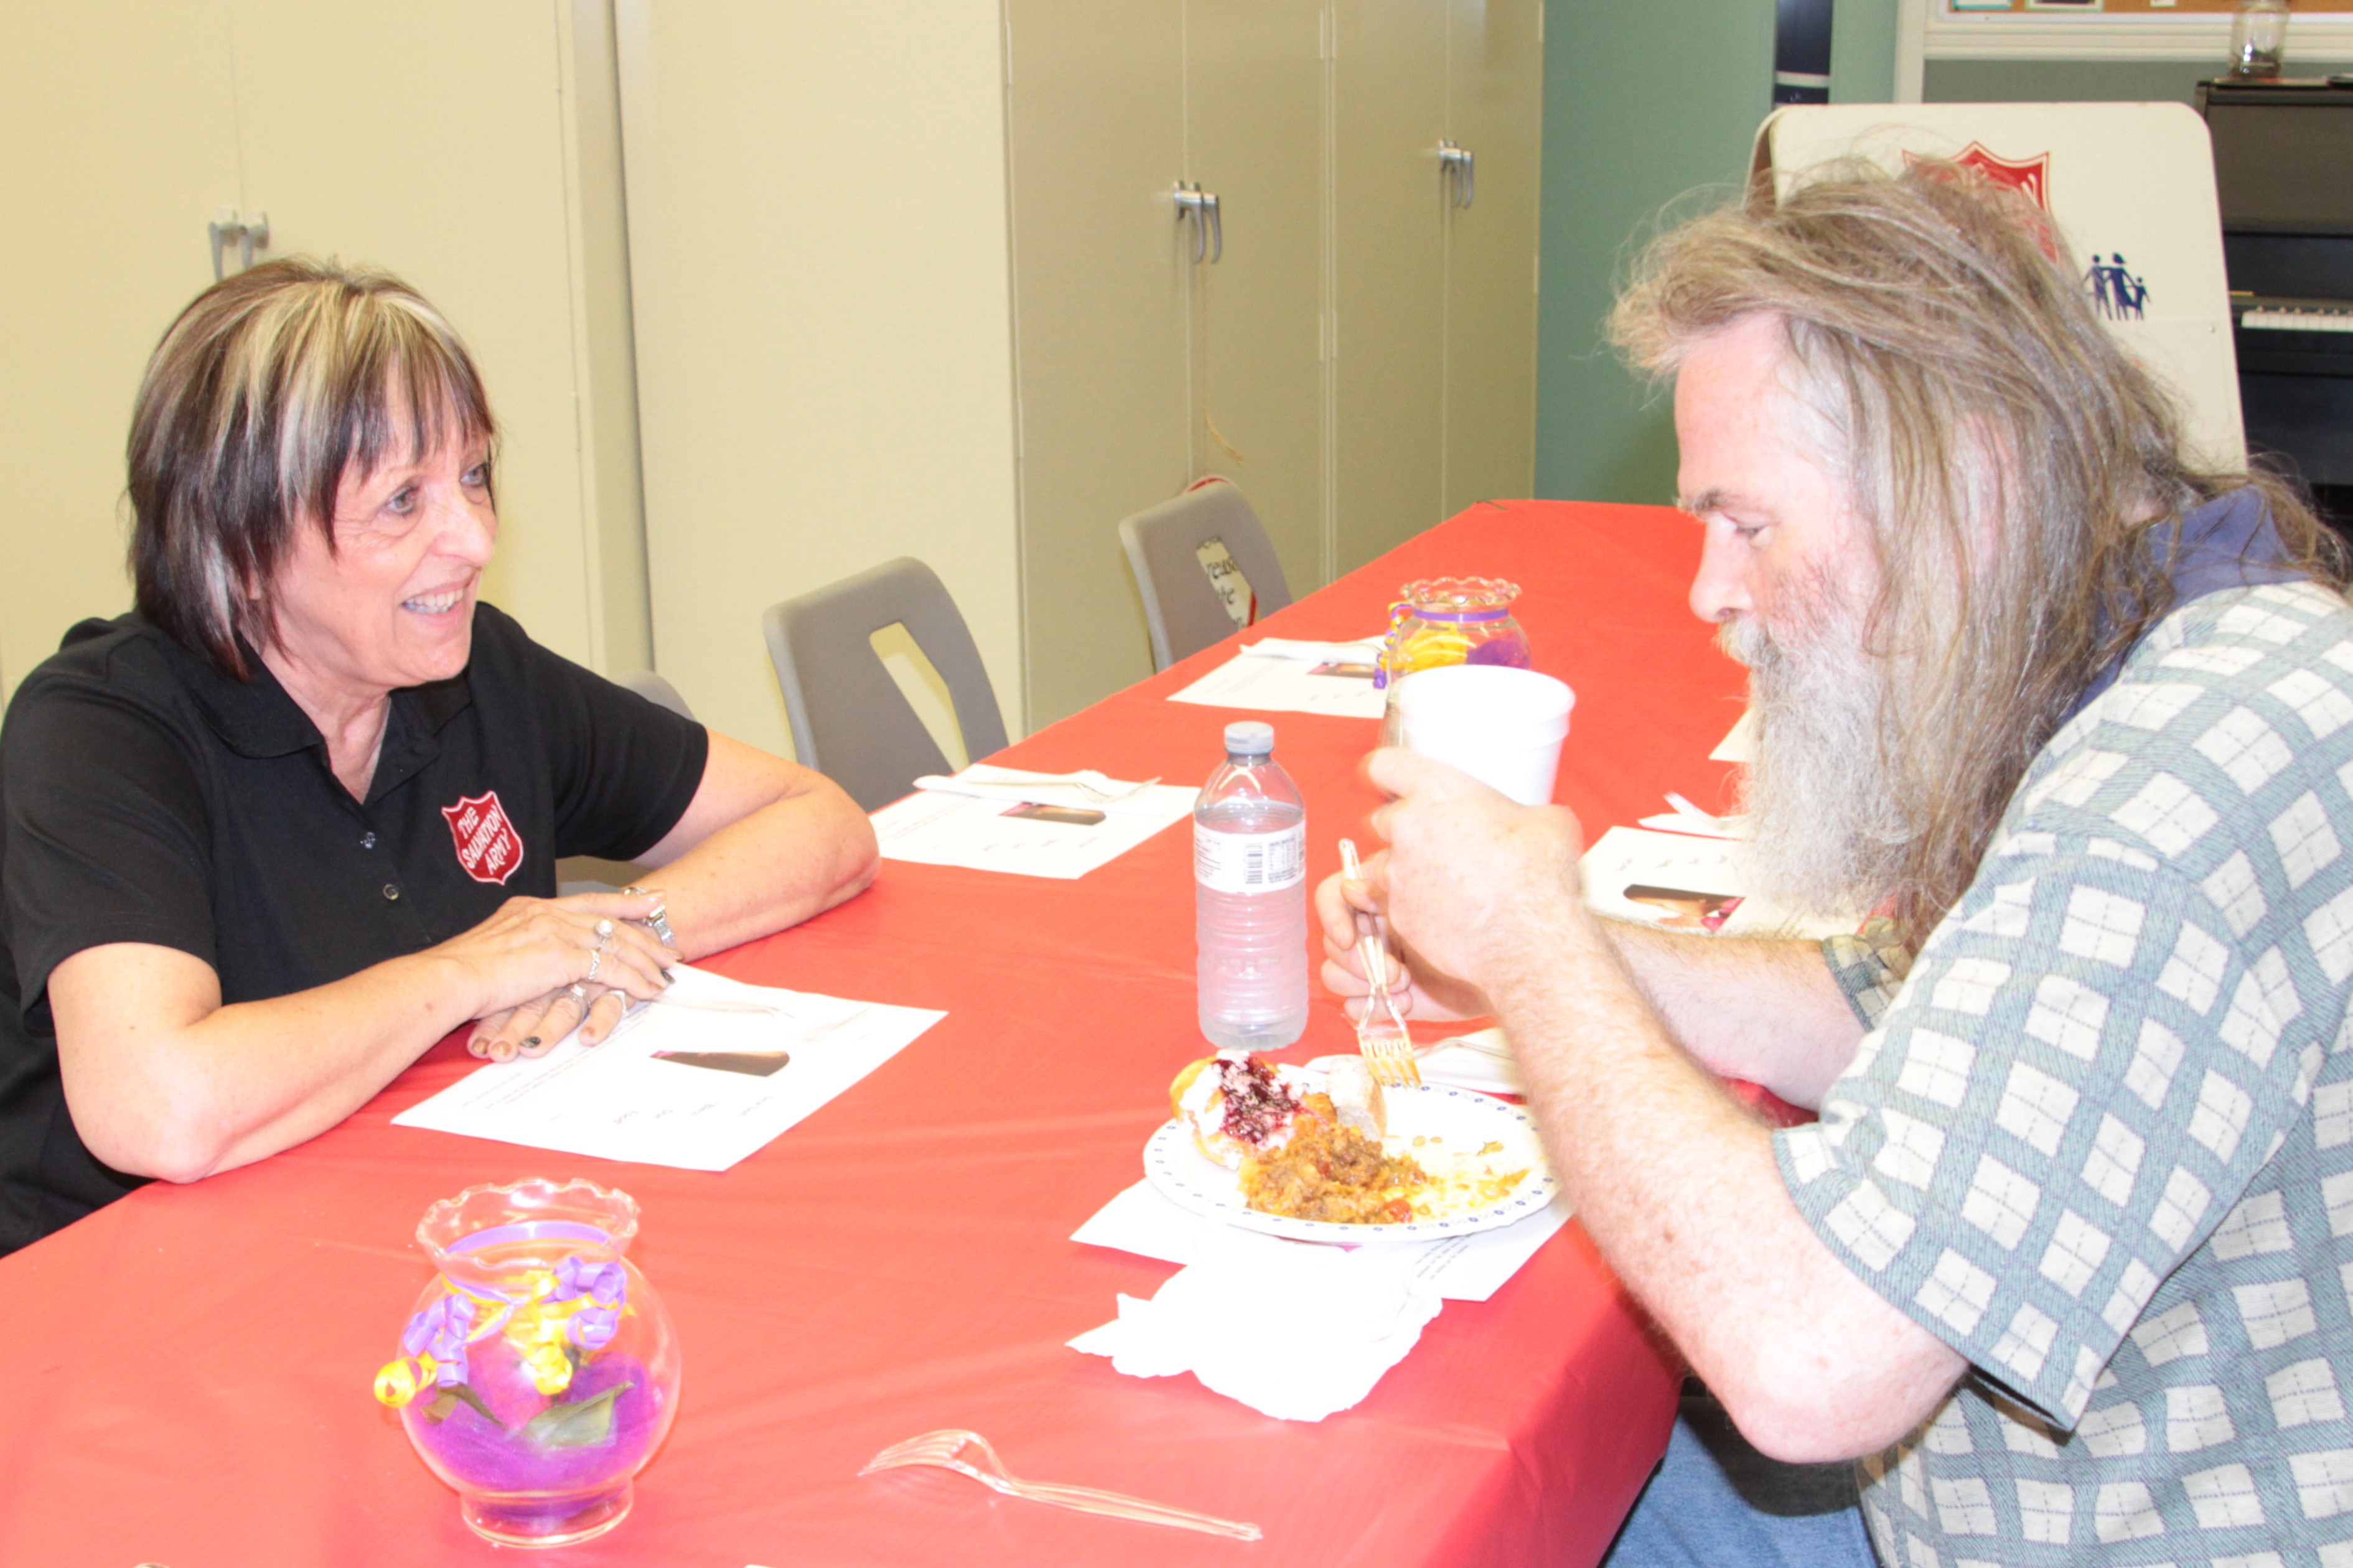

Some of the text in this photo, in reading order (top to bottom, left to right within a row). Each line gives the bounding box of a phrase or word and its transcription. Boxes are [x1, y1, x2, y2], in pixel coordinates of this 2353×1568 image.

[457, 806, 479, 840] THE
[461, 804, 502, 869] SALVATION
[484, 827, 512, 875] ARMY
